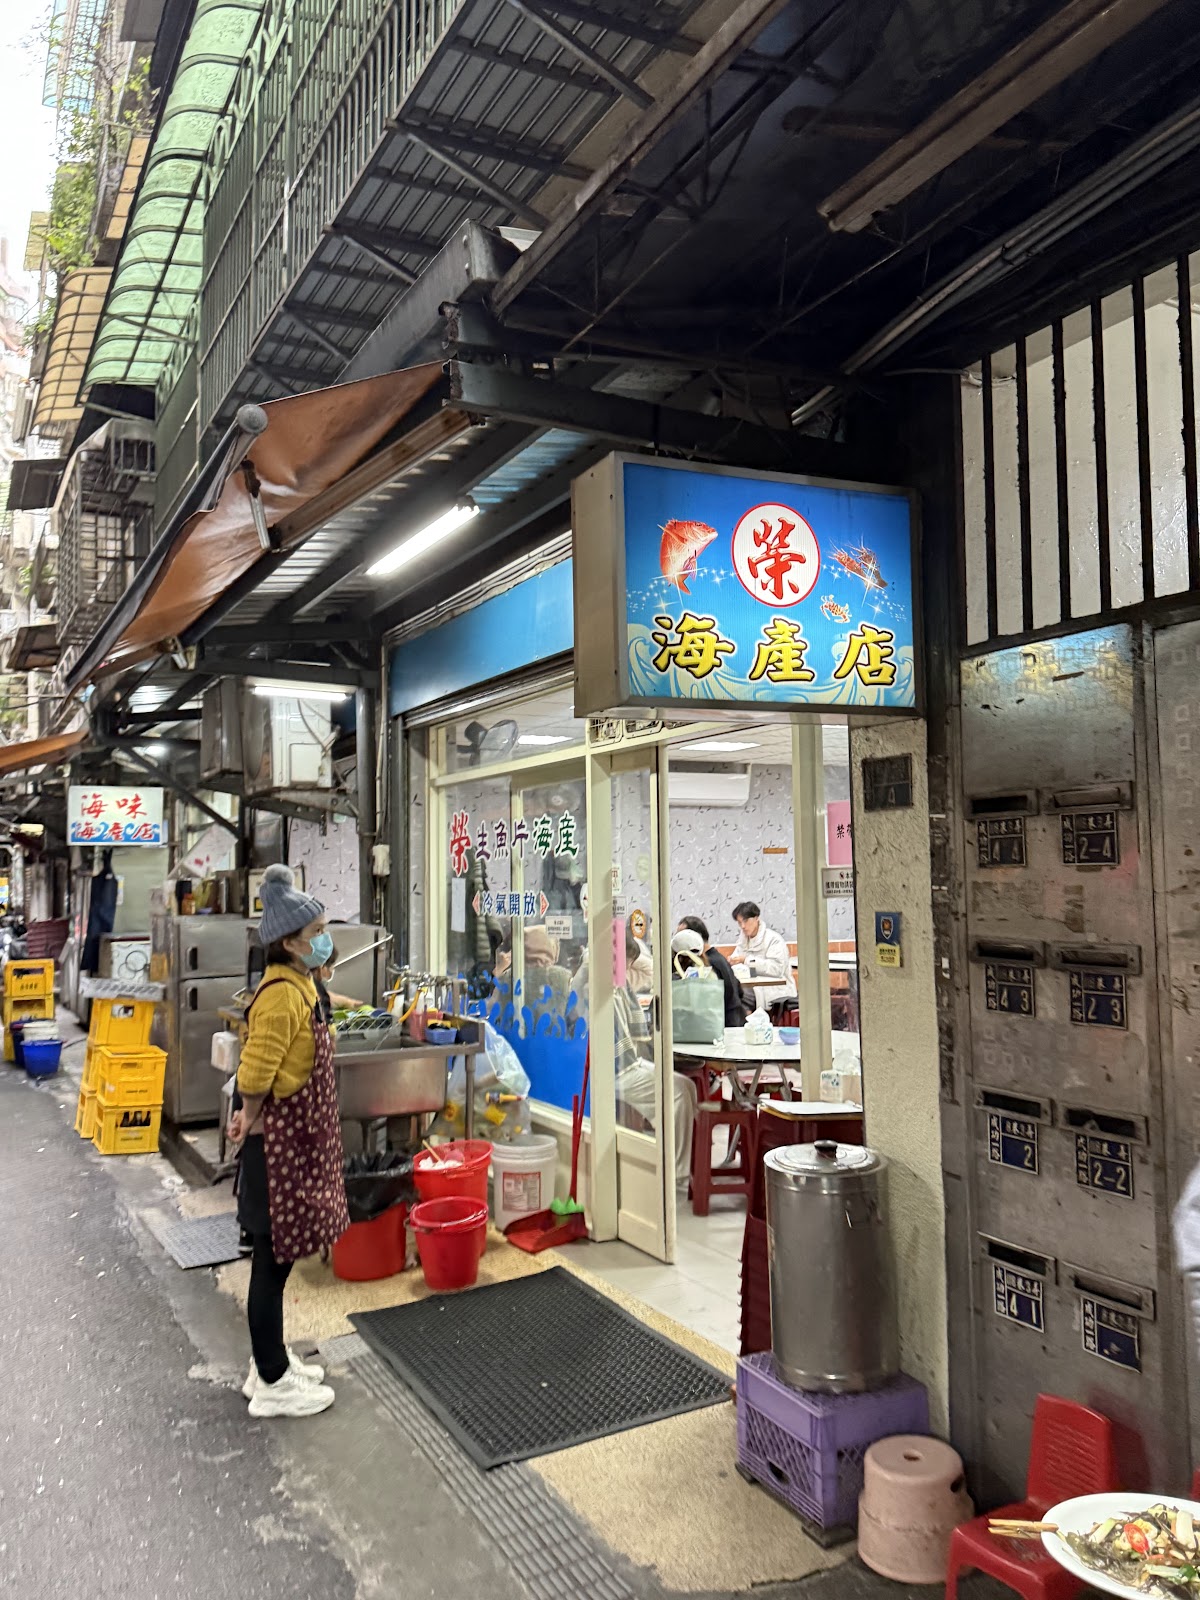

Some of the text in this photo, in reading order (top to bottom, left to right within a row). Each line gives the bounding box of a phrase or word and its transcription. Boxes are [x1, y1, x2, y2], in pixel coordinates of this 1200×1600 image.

[746, 516, 806, 600] 榮
[652, 612, 896, 686] 海產店
[81, 793, 147, 819] 海味
[482, 891, 536, 917] 冷氣開放
[1023, 1144, 1035, 1168] 2
[1092, 1162, 1126, 1191] 2-2
